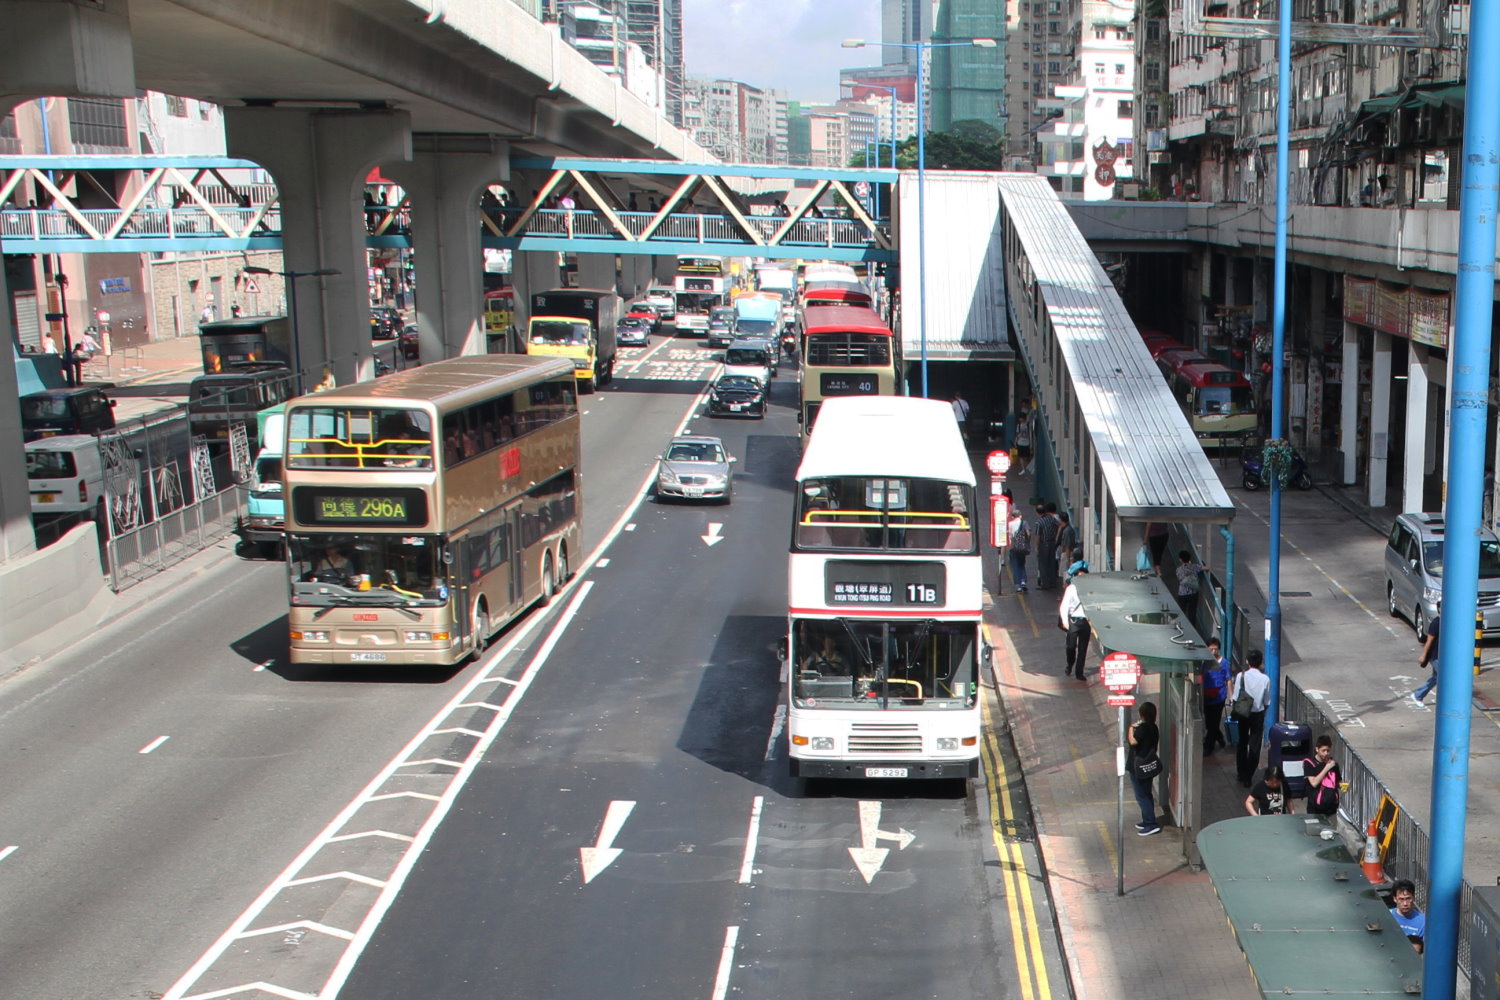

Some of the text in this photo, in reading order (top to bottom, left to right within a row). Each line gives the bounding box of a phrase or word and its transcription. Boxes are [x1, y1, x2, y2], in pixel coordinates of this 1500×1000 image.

[859, 382, 871, 392] 40
[360, 498, 405, 518] 296A
[907, 584, 936, 602] 11B
[883, 769, 906, 777] 5292
